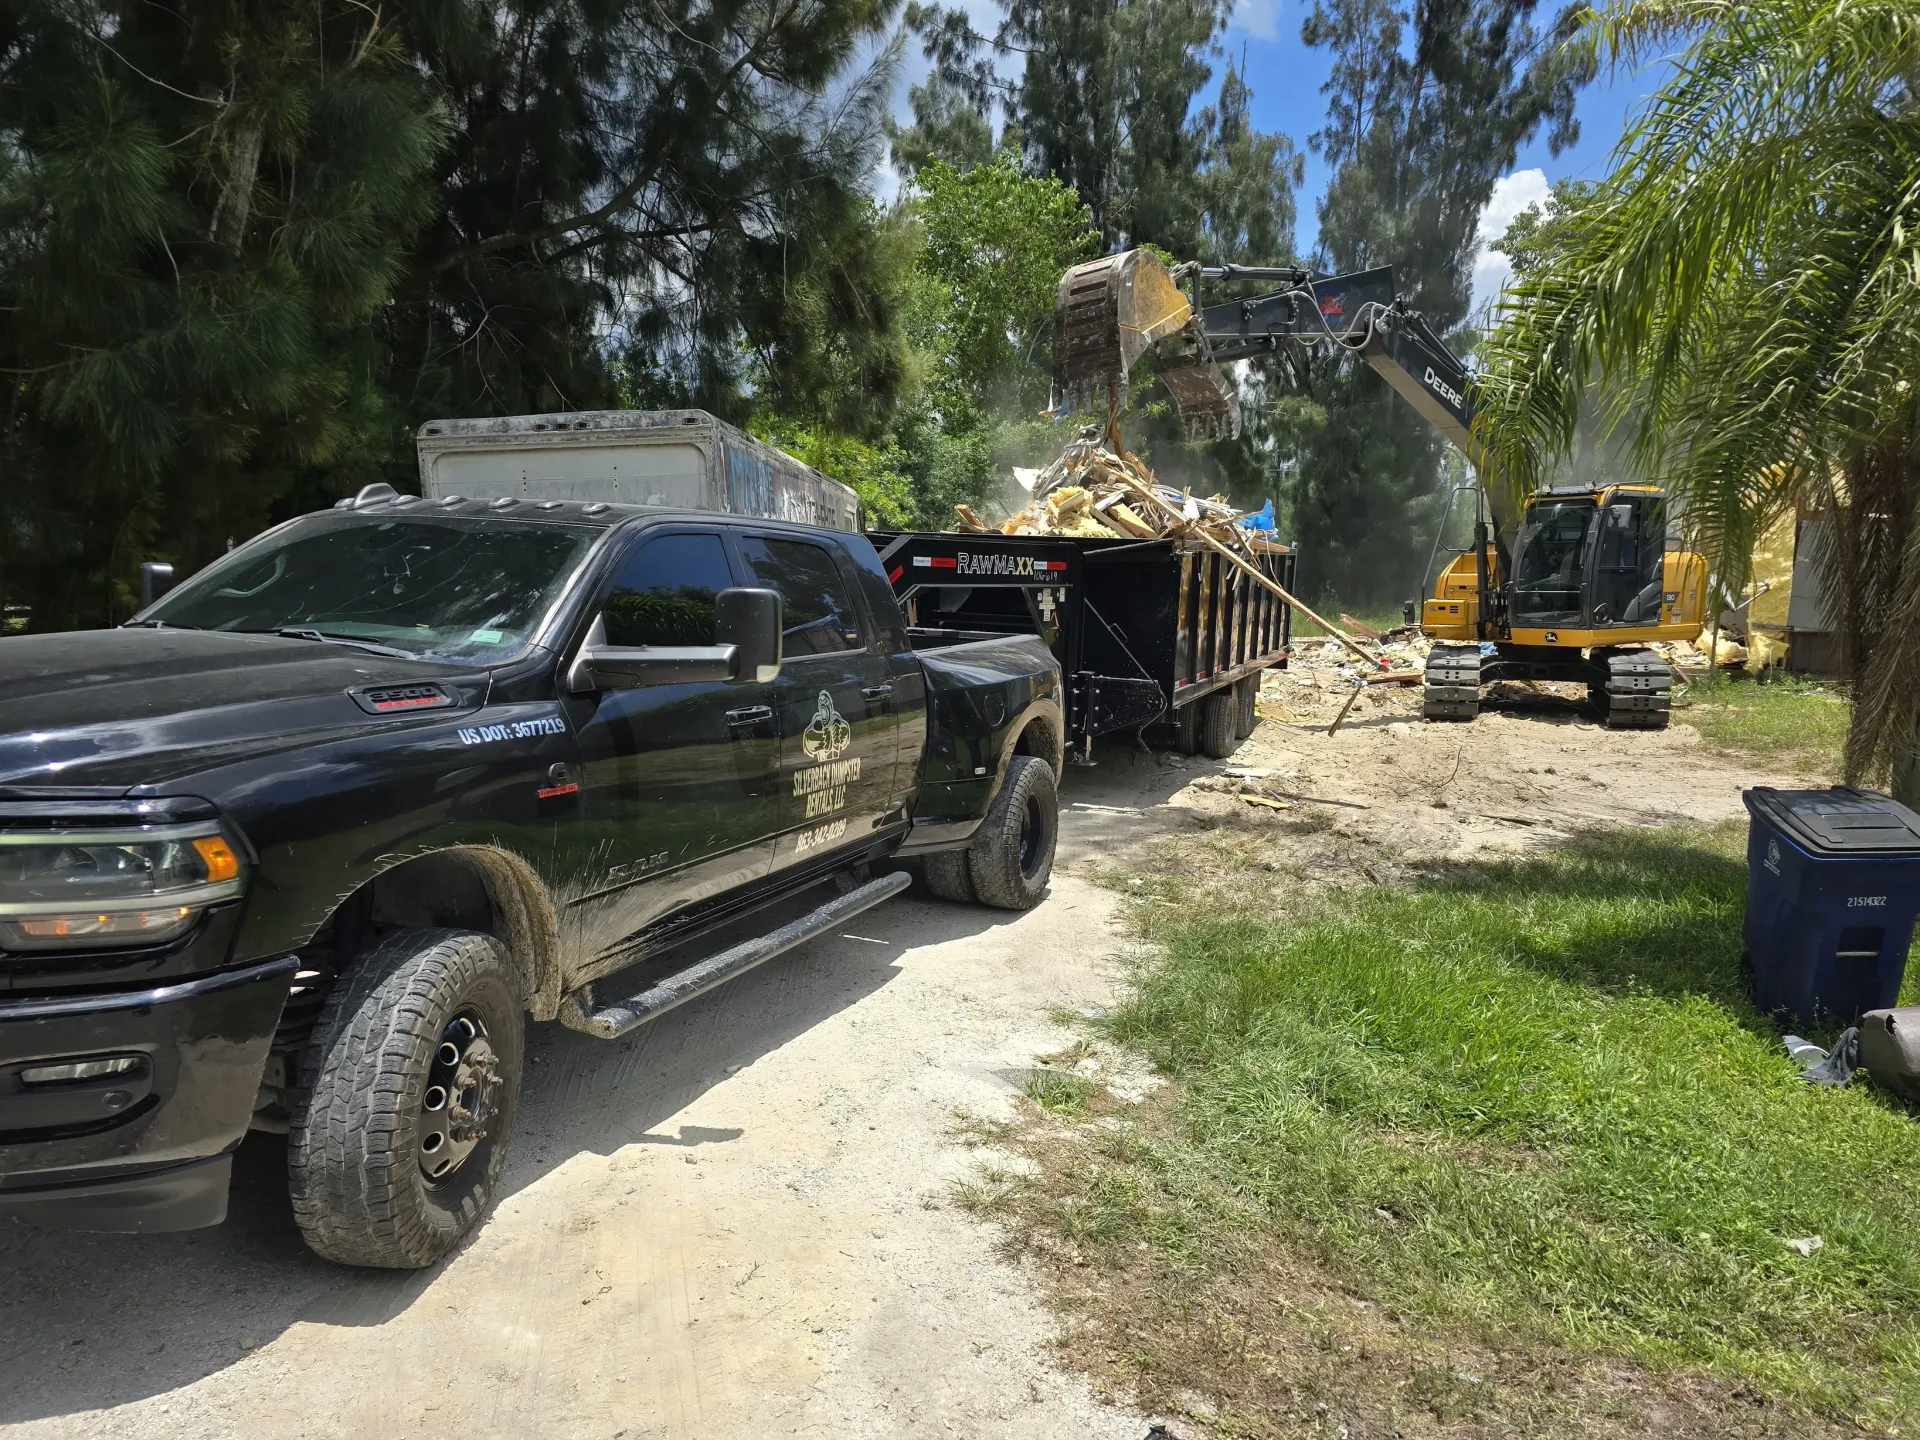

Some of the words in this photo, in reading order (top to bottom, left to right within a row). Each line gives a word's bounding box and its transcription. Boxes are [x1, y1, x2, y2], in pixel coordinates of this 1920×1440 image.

[1424, 366, 1463, 409] DEERE
[957, 552, 1034, 575] RAWMAXX
[458, 728, 481, 745] US
[479, 724, 514, 742] DOT:
[511, 718, 566, 738] 3677219
[793, 763, 832, 797] SILVERBACK
[831, 757, 861, 787] DUMPSTER
[834, 784, 846, 810] LLC
[795, 818, 847, 853] 863-342-0209
[1847, 896, 1887, 907] 21514322
